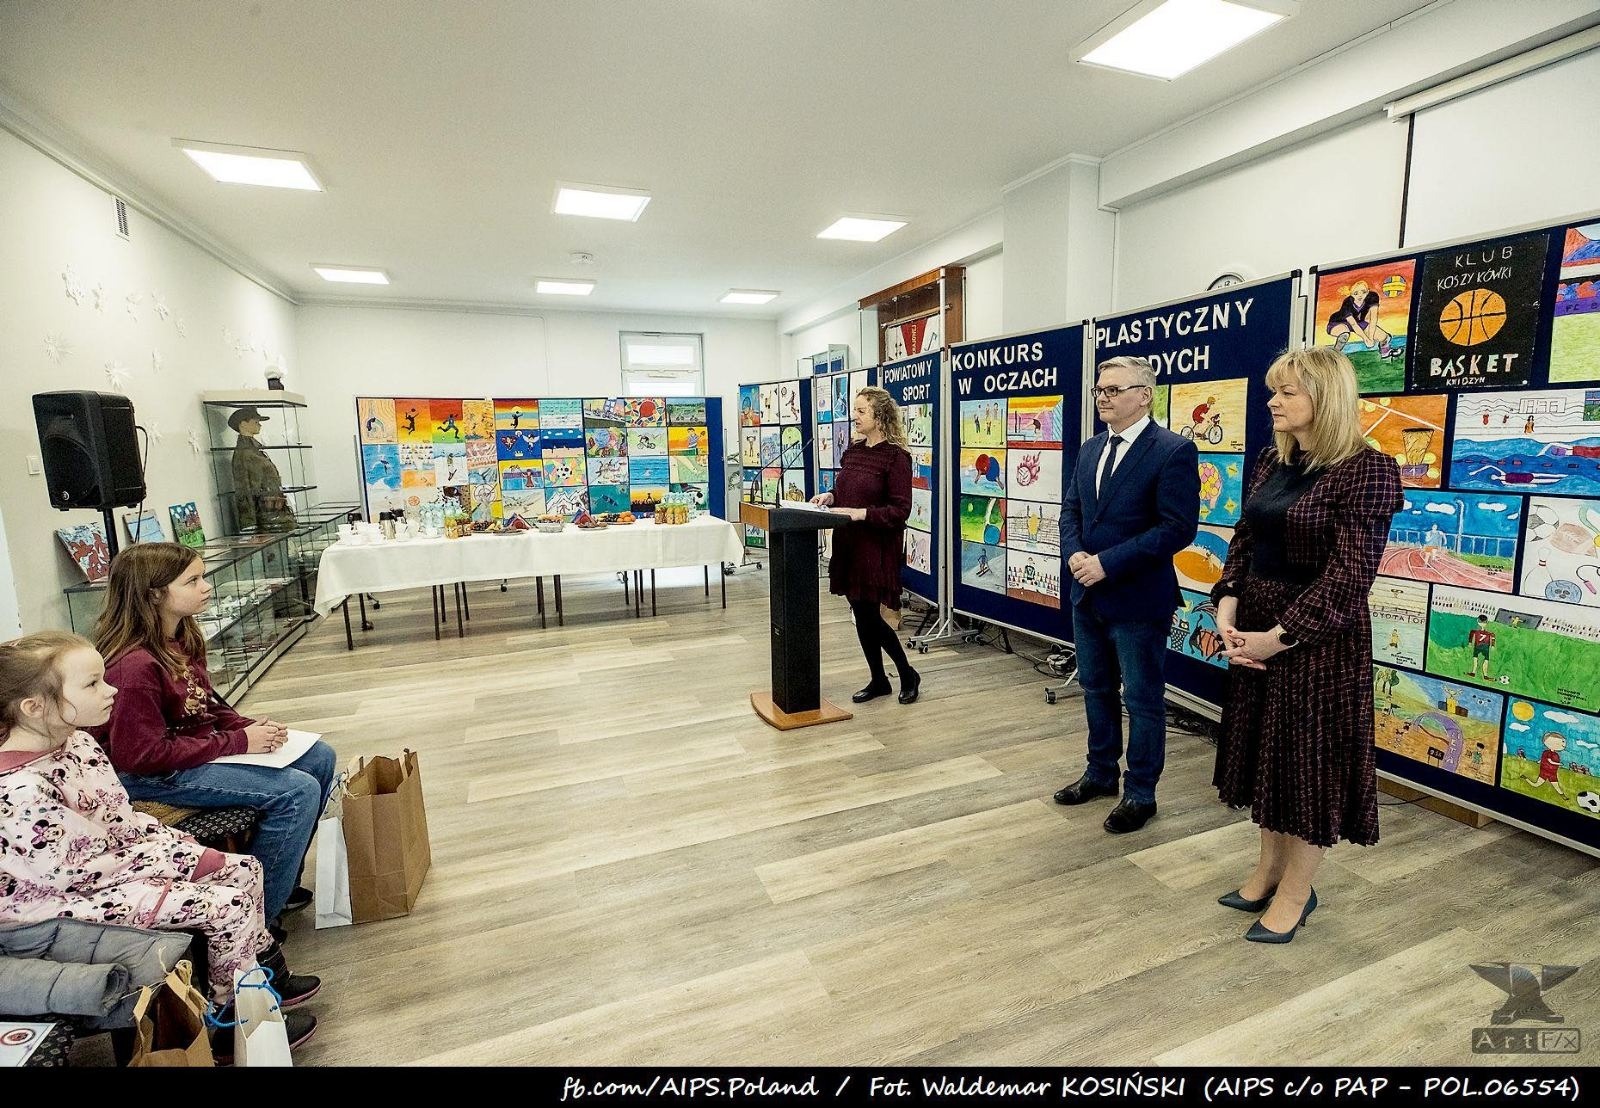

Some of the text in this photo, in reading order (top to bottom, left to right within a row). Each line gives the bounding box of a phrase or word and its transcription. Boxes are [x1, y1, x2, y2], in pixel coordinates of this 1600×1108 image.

[1455, 246, 1513, 268] KLUB
[1095, 298, 1254, 349] PLASTYCZNY
[952, 342, 1043, 371] KONKURS
[1430, 353, 1518, 377] BASKET
[884, 360, 933, 384] POWIATOWY
[958, 367, 1058, 395] W OCZACH
[902, 384, 931, 402] SPORT
